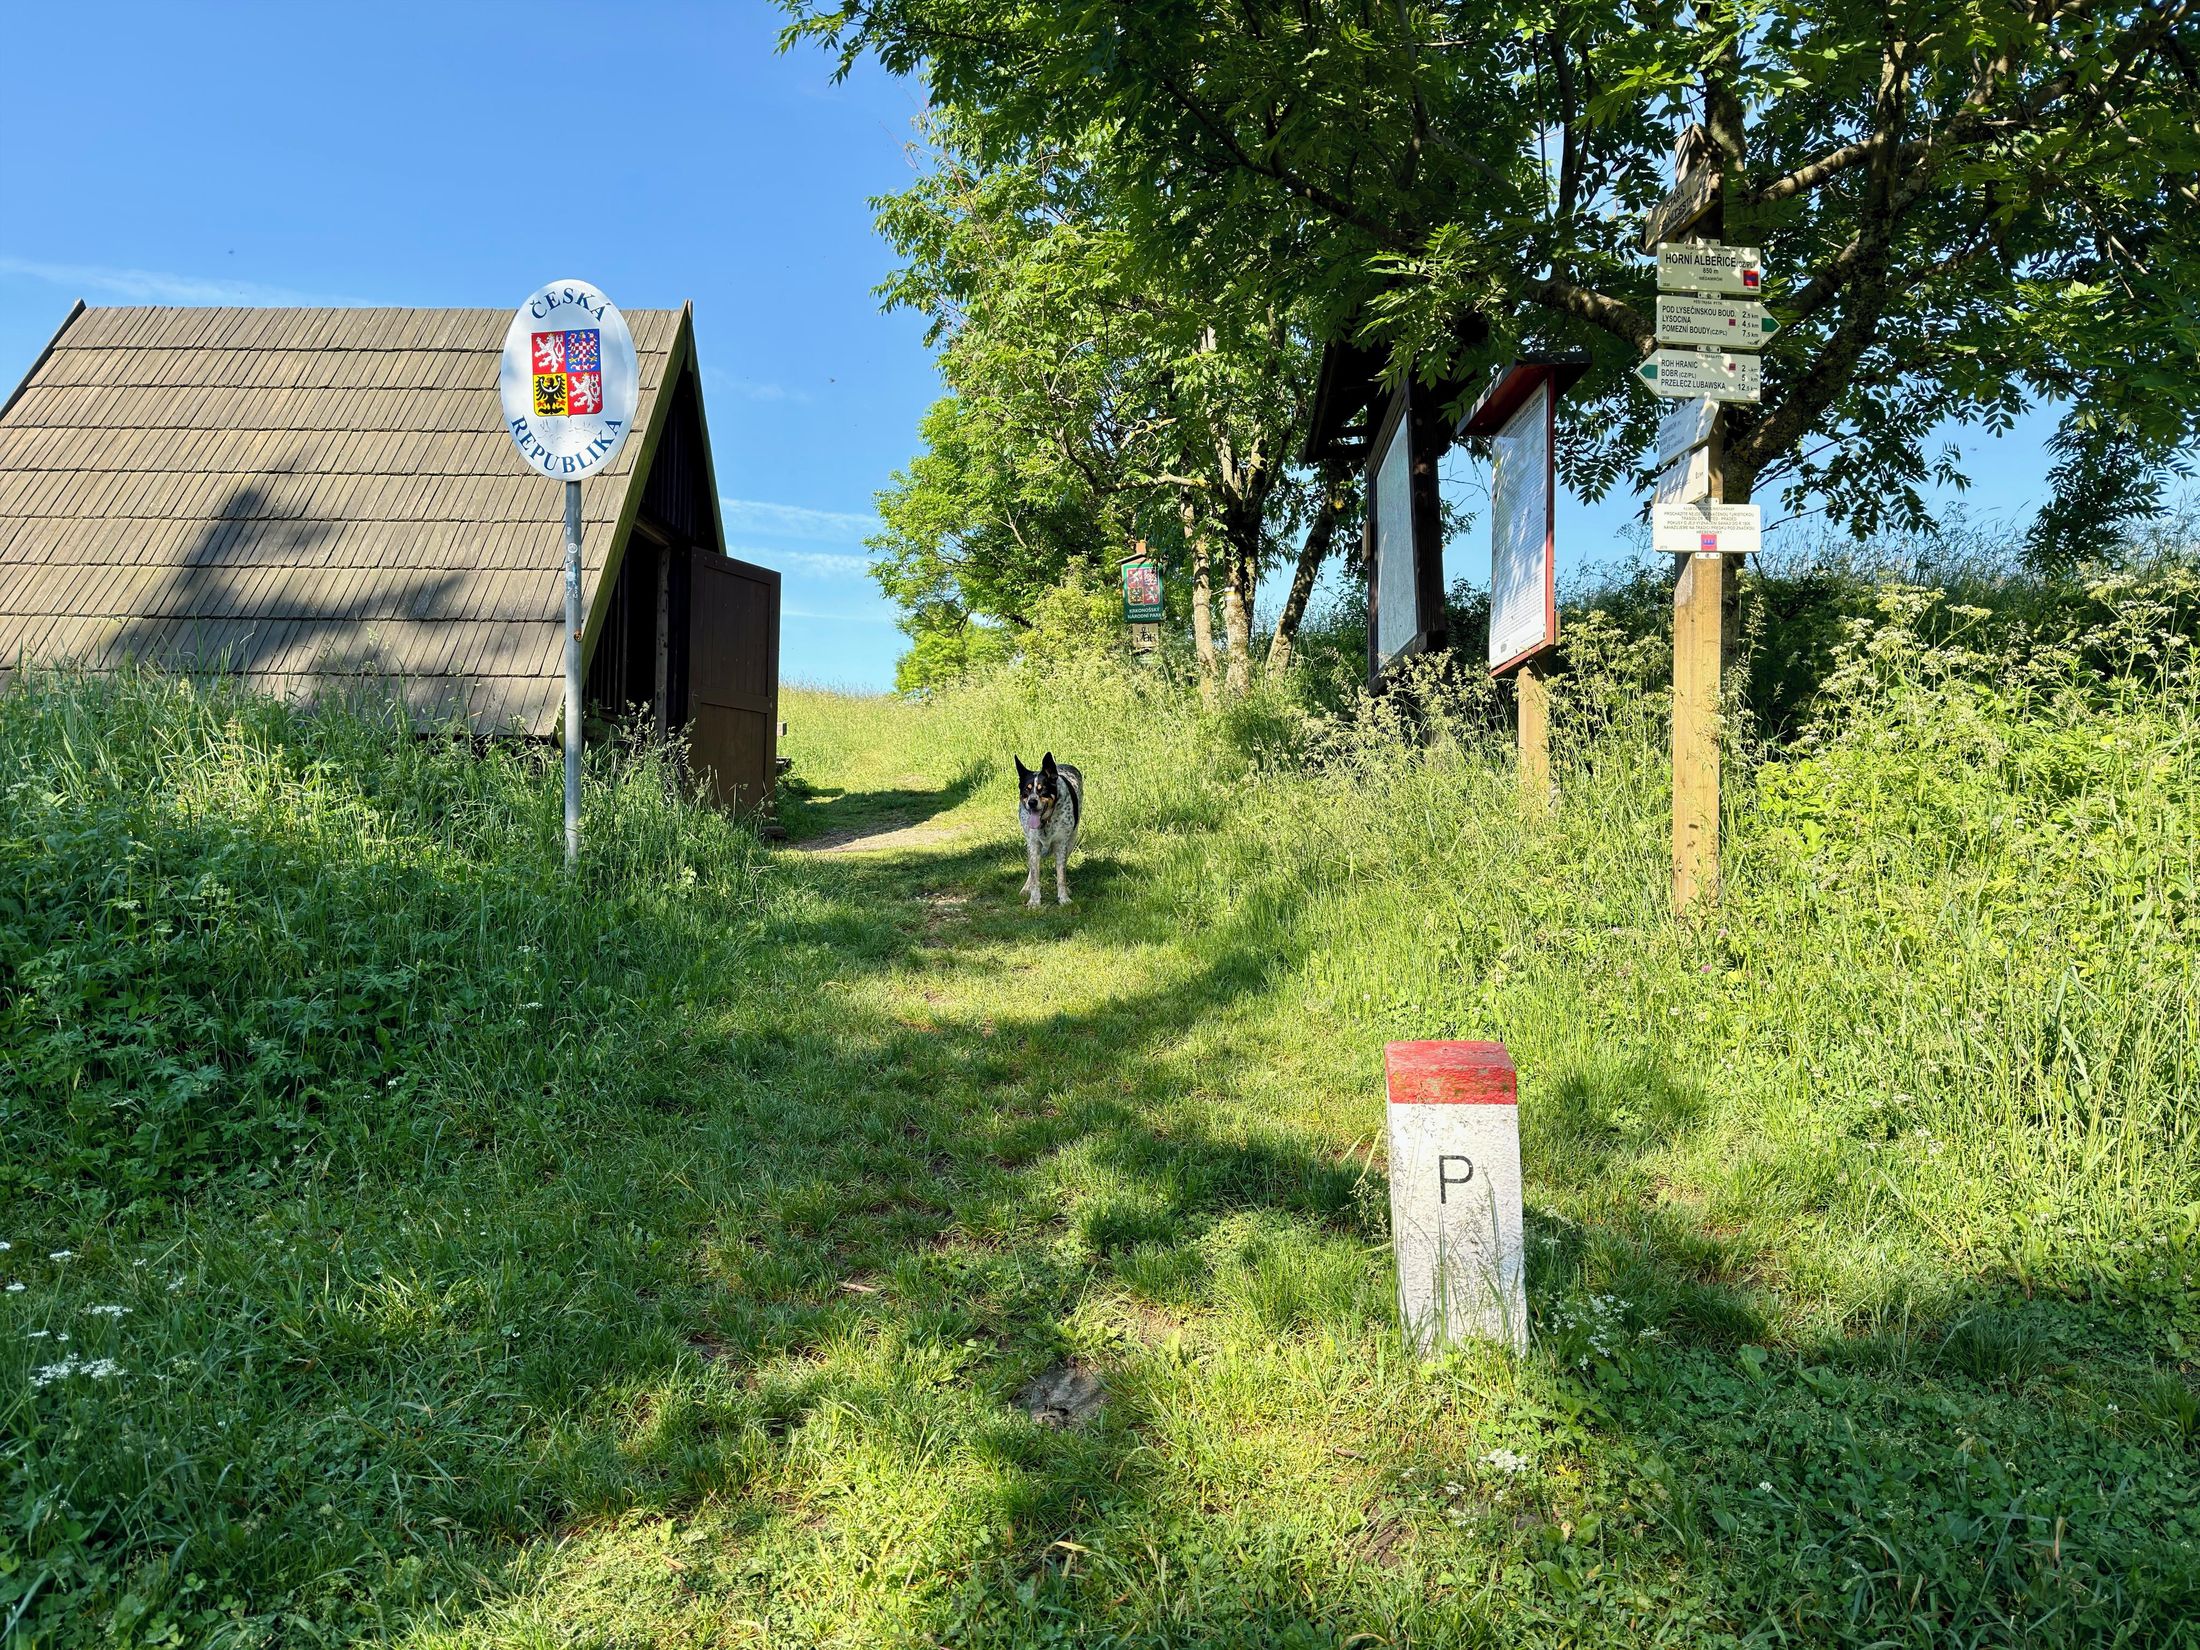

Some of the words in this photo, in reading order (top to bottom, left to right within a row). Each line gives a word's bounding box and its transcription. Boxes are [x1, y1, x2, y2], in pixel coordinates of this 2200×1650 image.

[1665, 252, 1693, 265] HORNÍ
[1694, 253, 1736, 268] ALBEŘICE
[529, 287, 612, 322] ČESKÁ
[1662, 305, 1675, 313] POD
[1676, 306, 1717, 316] LYSEČINSKOU
[1662, 324, 1688, 333] POMEZNÍ
[1690, 325, 1710, 335] BOUDY
[1742, 320, 1750, 328] 4,5
[1742, 329, 1750, 337] 7,5
[1661, 359, 1674, 367] ROH
[1675, 360, 1698, 369] HRANIC
[1661, 368, 1679, 377] BOBR
[1693, 380, 1726, 390] LUBAWSKA
[511, 415, 624, 474] REPUBLIKA
[1438, 1154, 1474, 1205] P
